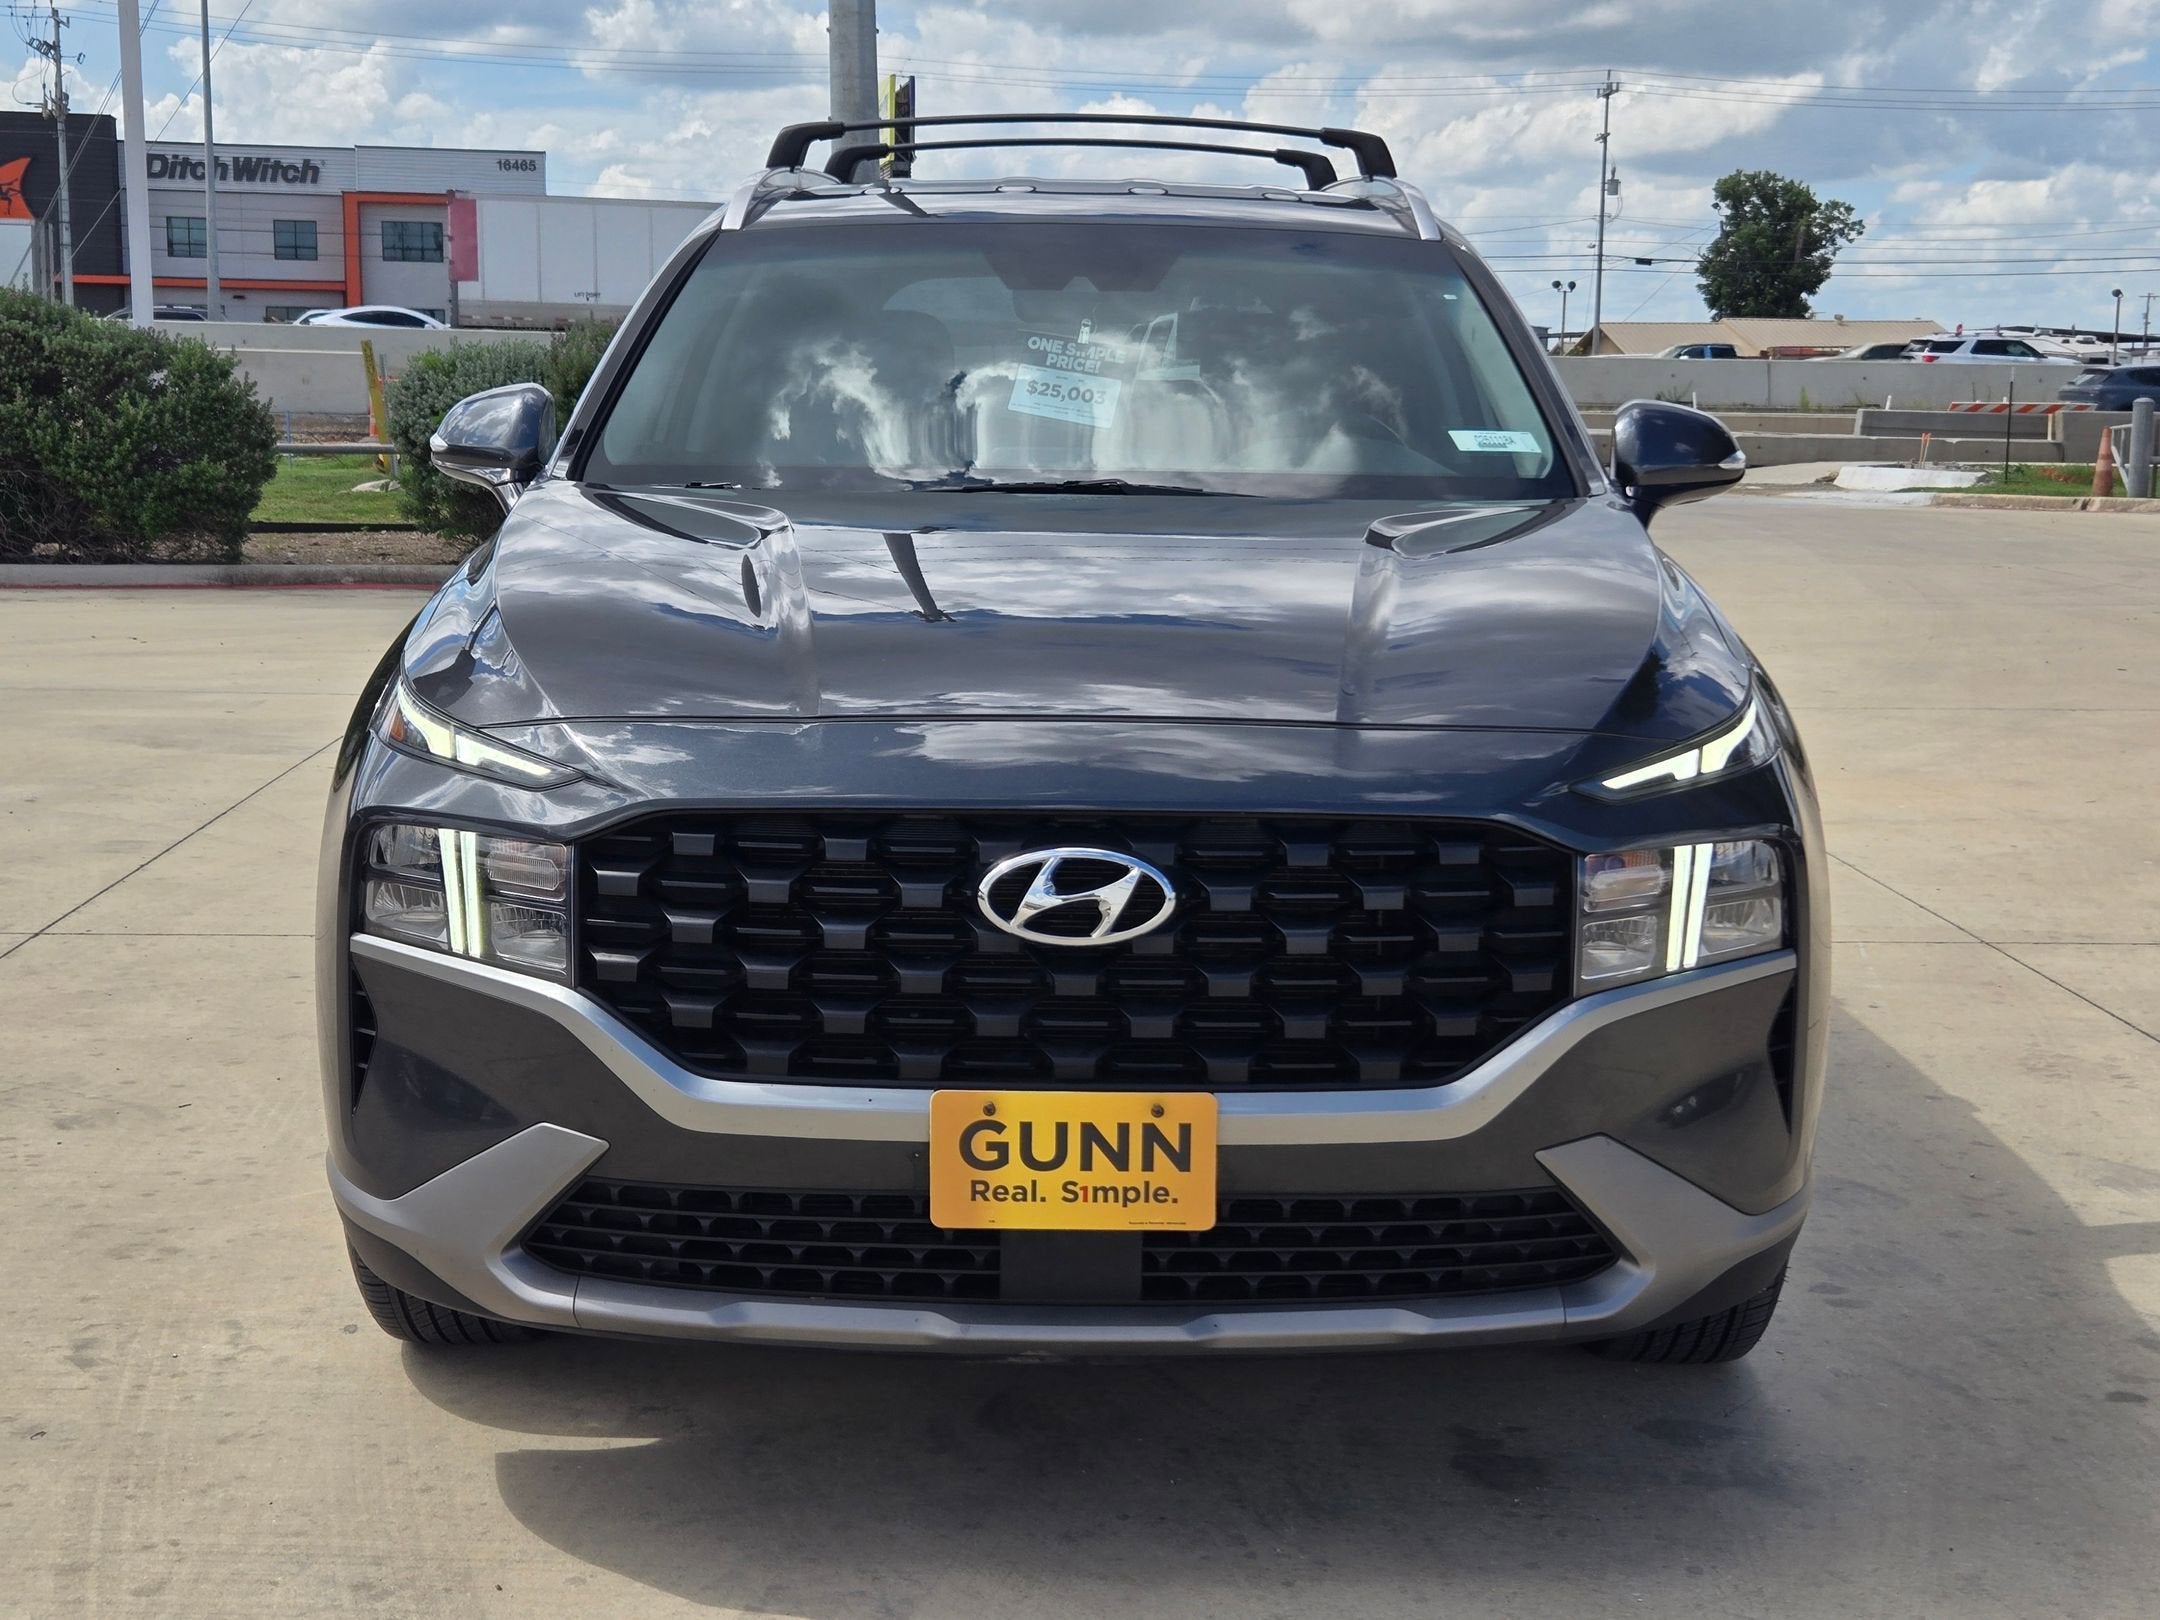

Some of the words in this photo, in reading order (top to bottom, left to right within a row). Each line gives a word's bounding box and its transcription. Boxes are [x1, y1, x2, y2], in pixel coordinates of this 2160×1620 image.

[146, 153, 229, 181] Ditch
[232, 156, 321, 184] Witch
[1027, 336, 1064, 354] ONE
[1046, 353, 1101, 374] PRICE!
[958, 1118, 1192, 1173] GUNN
[970, 1179, 1047, 1203] Real.
[1061, 1180, 1179, 1208] S1mple.
